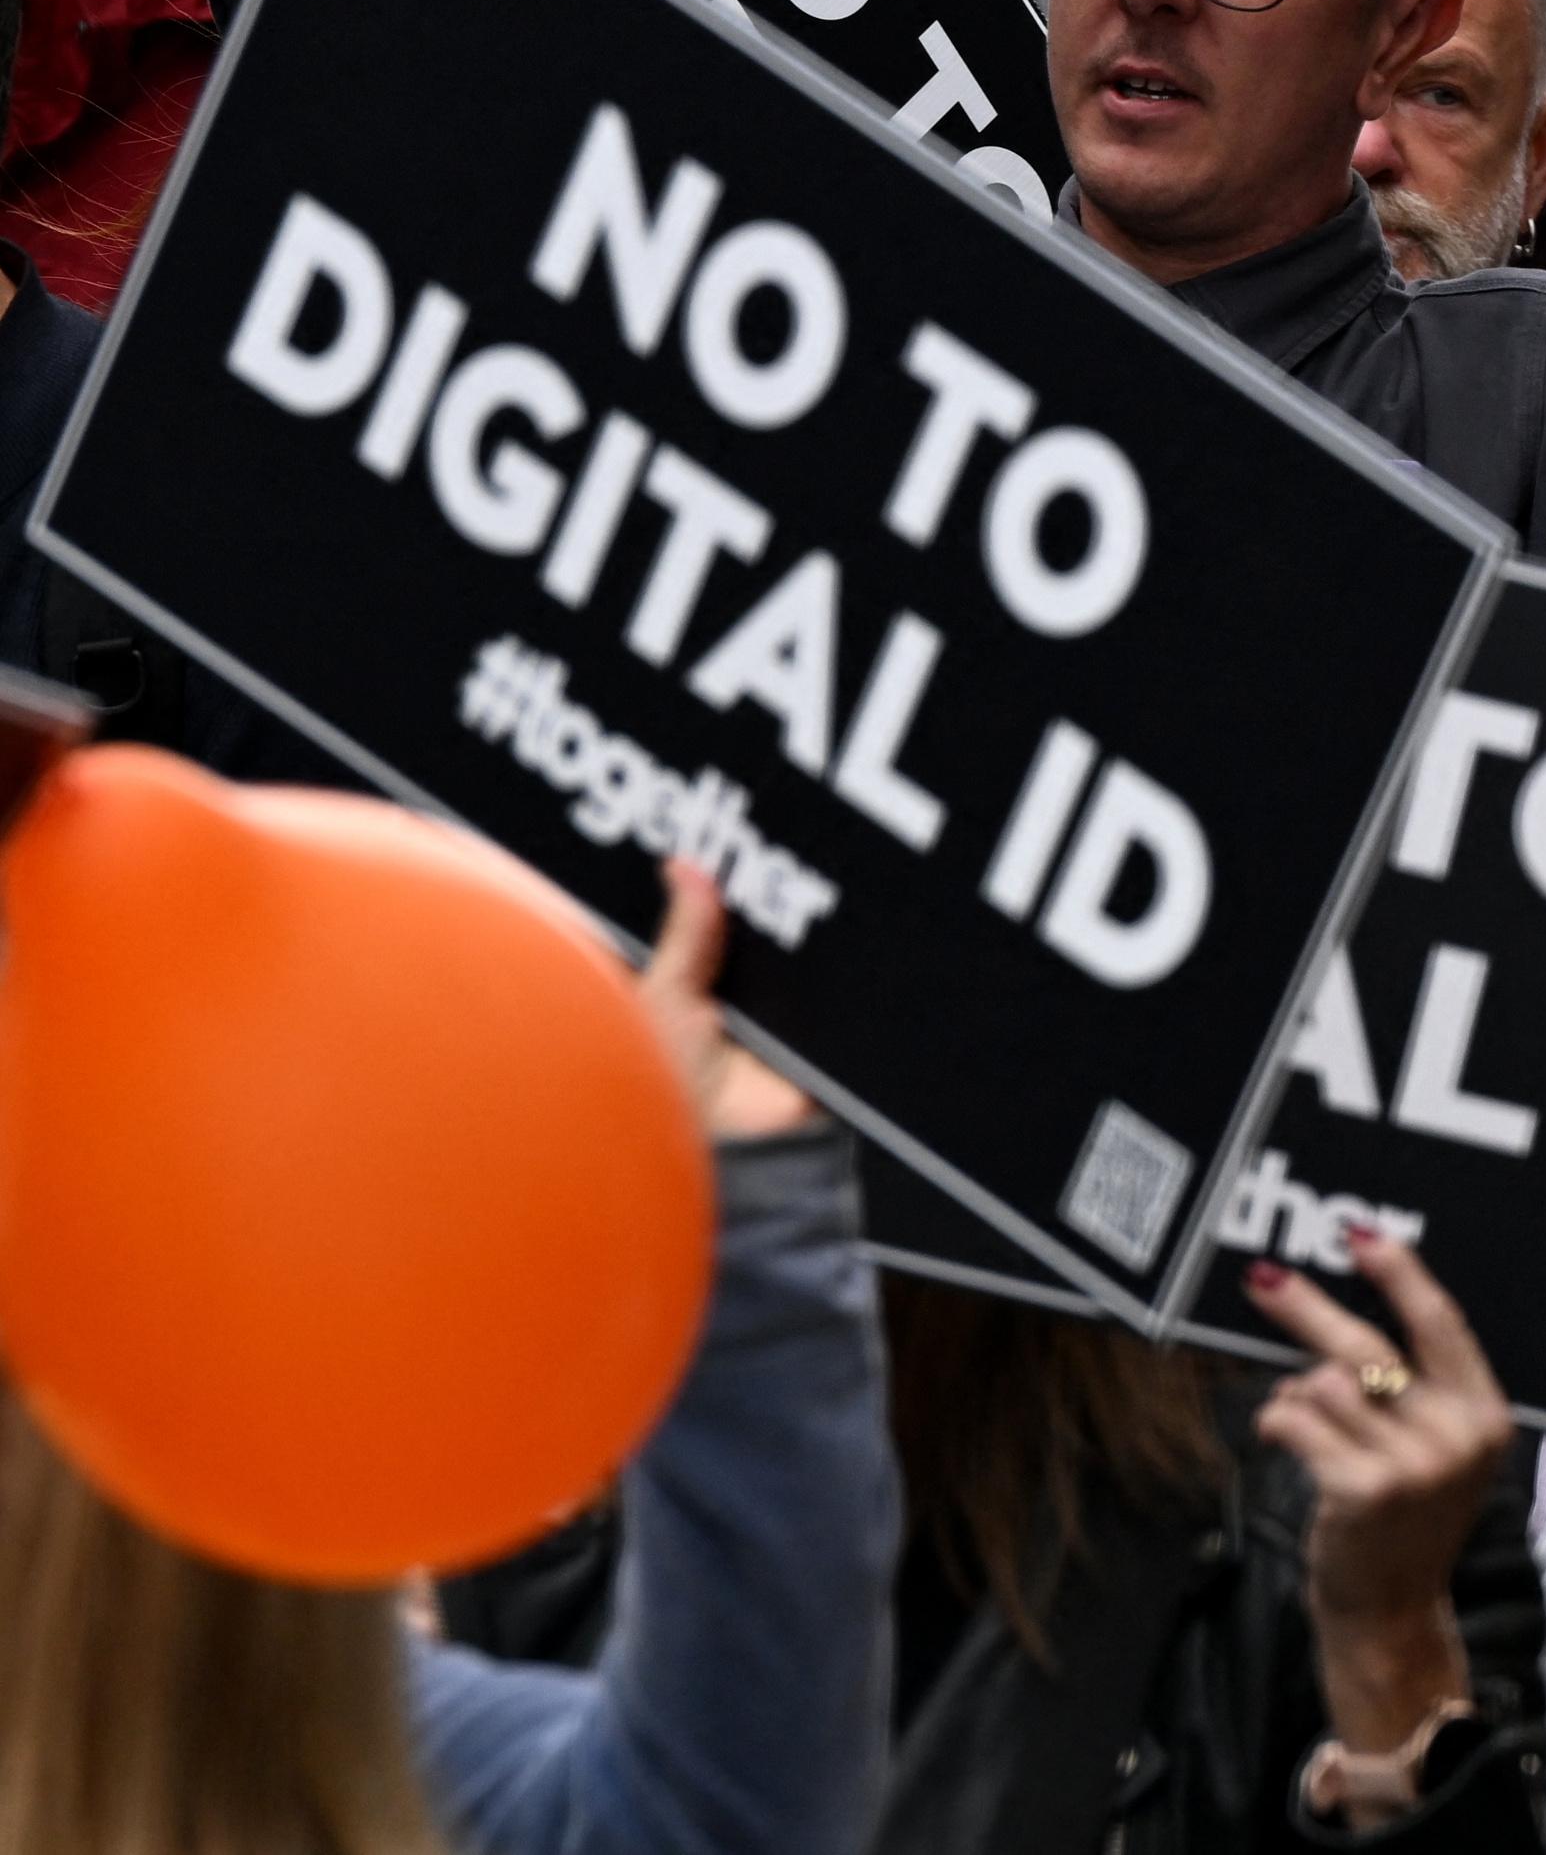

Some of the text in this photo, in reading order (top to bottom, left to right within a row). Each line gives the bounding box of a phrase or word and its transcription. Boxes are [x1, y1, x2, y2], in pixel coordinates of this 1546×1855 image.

[224, 191, 1213, 990] DIGITAL ID
[530, 104, 1151, 638] NO TO
[456, 635, 840, 952] #together
